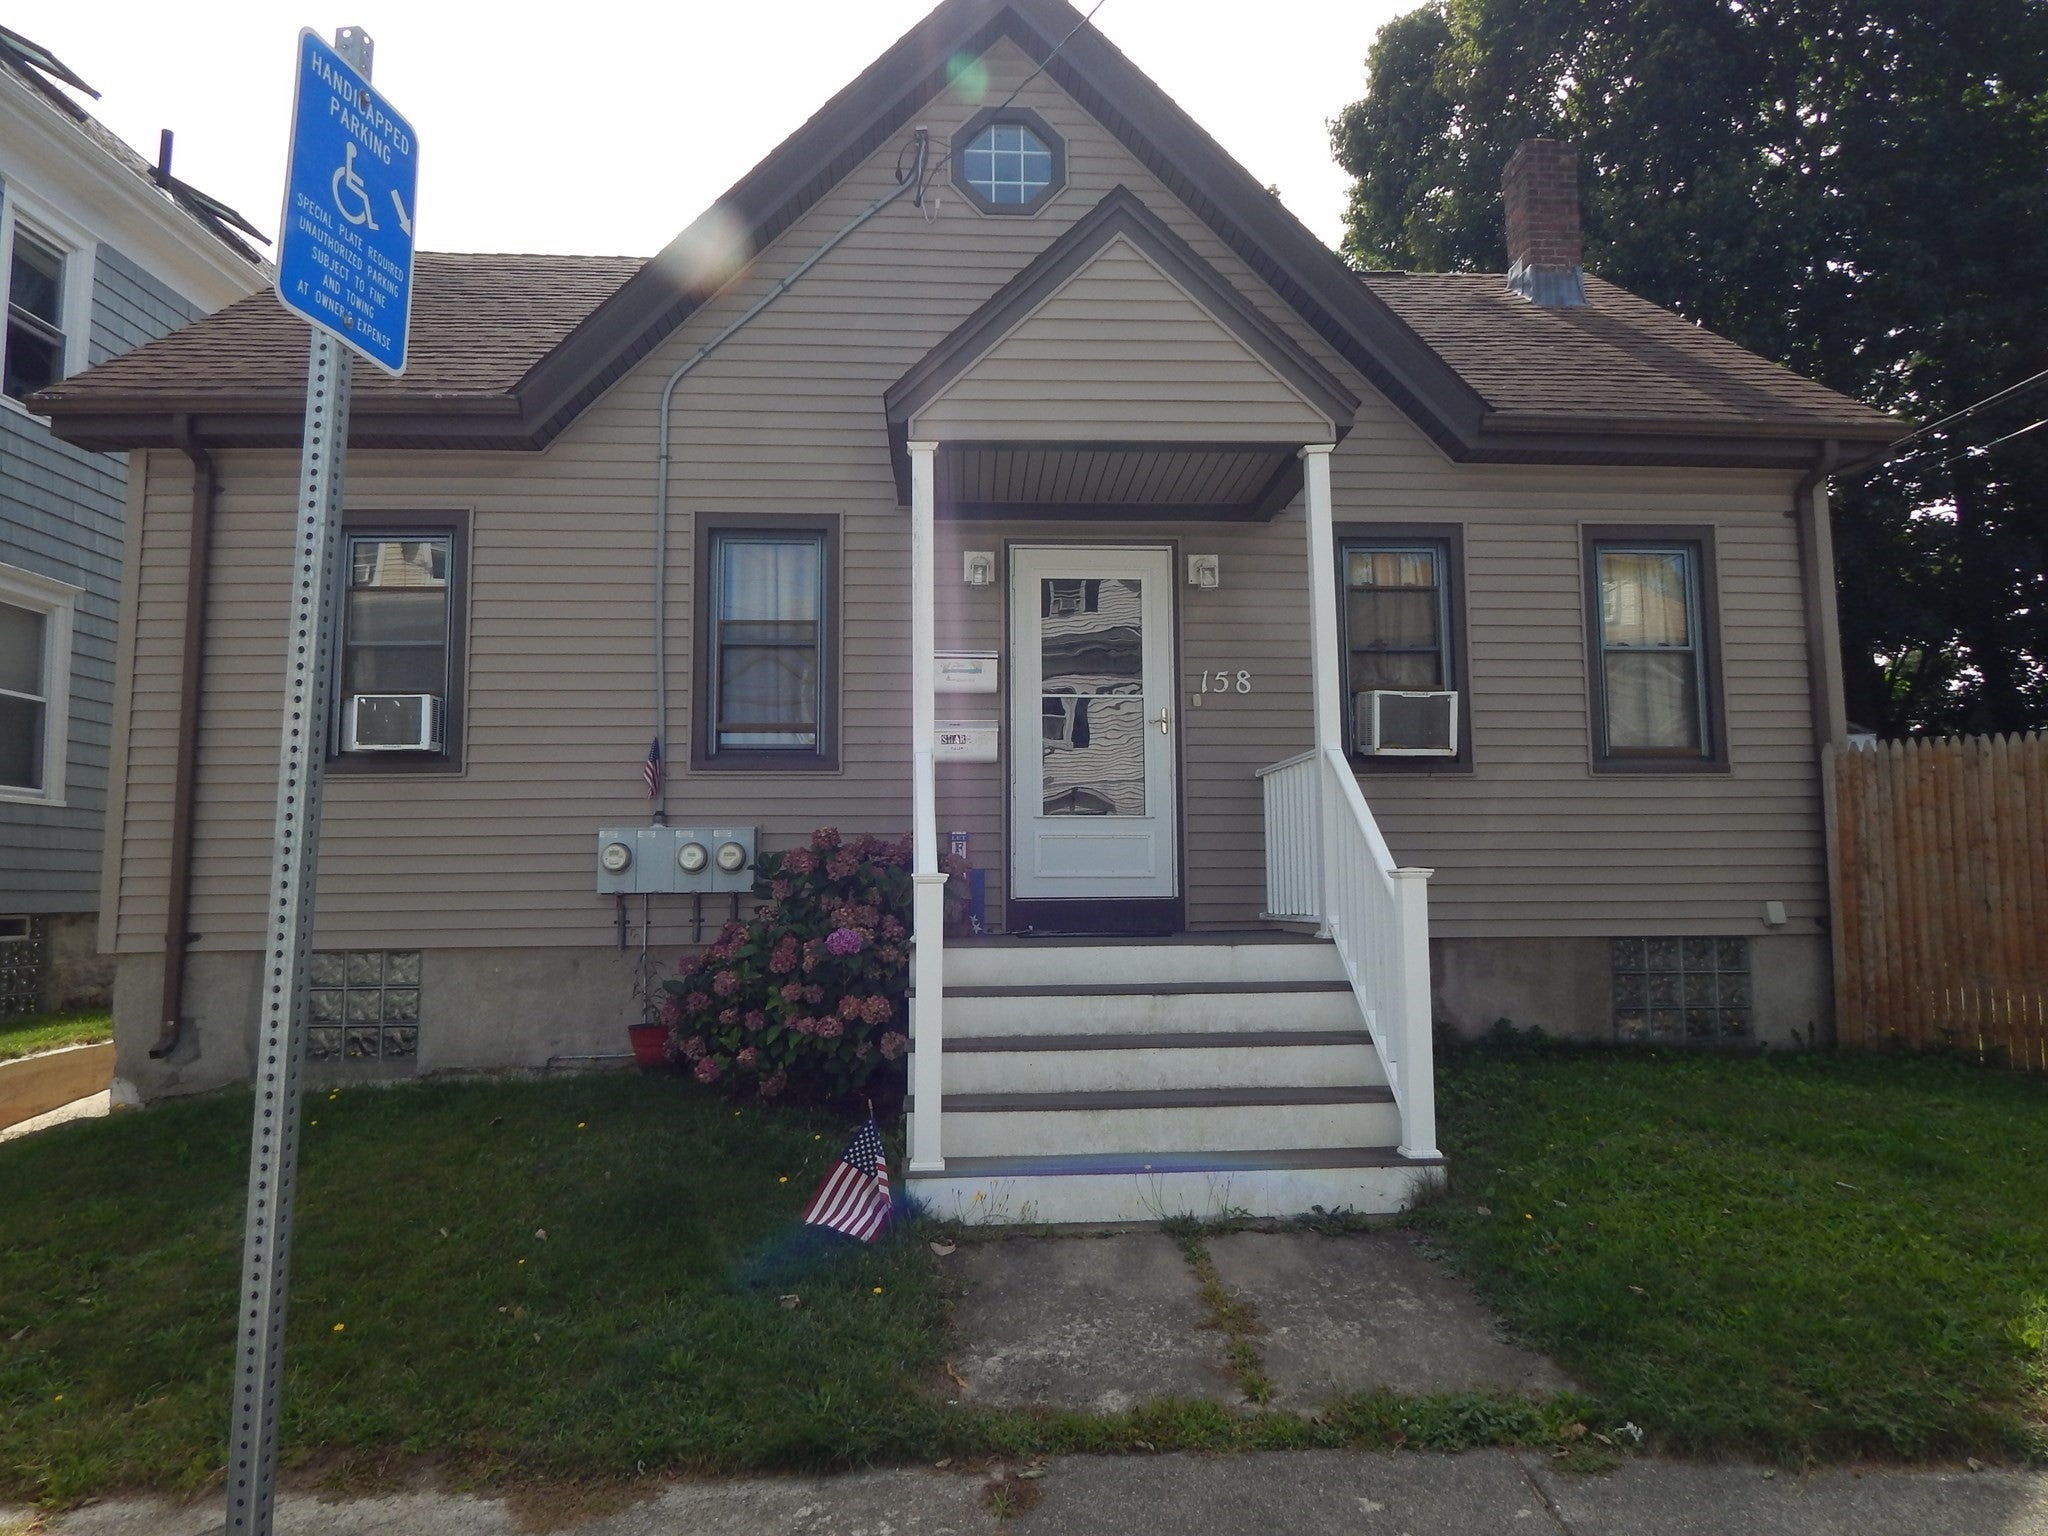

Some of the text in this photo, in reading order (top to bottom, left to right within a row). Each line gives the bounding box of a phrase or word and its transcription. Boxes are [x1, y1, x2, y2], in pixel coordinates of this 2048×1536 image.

[311, 51, 409, 155] HANDICAPPED
[330, 96, 391, 165] PARKING
[297, 193, 404, 282] SPECIAL PLATE REQUIRED
[300, 216, 399, 298] UNAUTHORIZED PARKING
[311, 246, 387, 309] SUBJECT TO FINE
[322, 274, 375, 319] AND TOWING
[297, 279, 309, 296] AT
[357, 318, 391, 351] EXPENSE
[1201, 670, 1251, 694] 158
